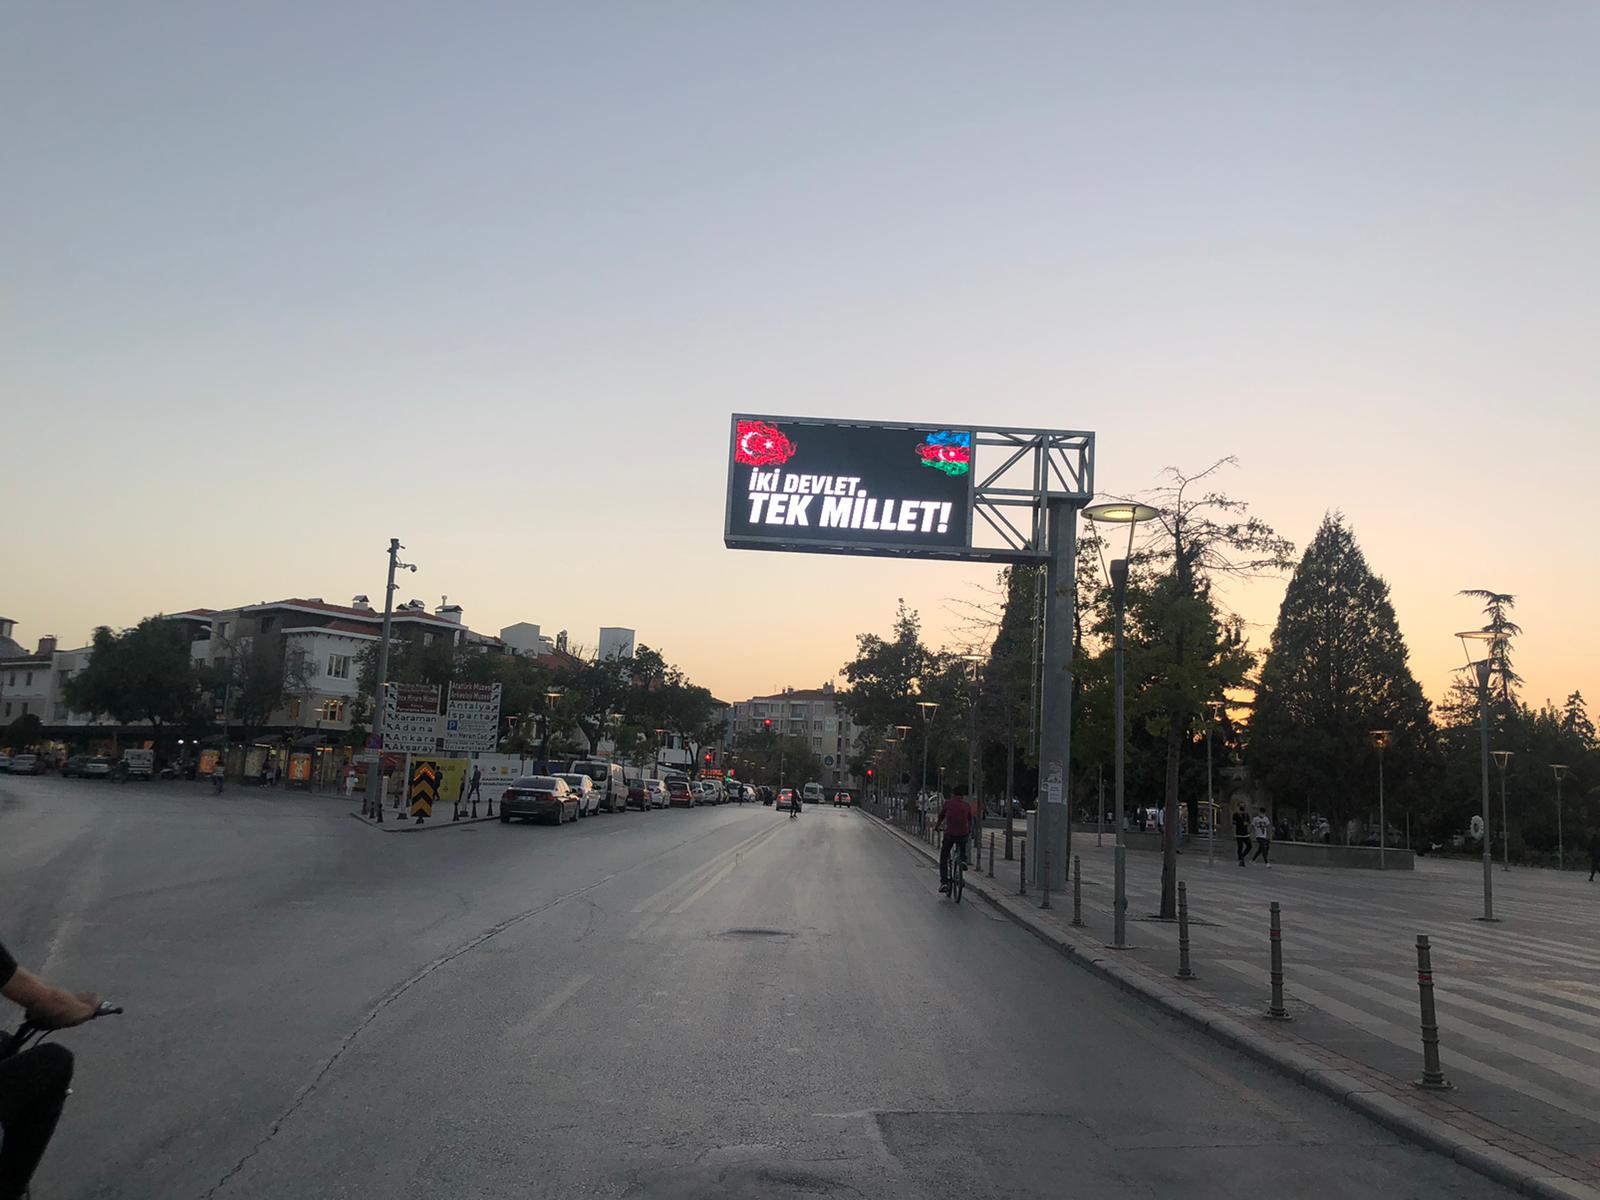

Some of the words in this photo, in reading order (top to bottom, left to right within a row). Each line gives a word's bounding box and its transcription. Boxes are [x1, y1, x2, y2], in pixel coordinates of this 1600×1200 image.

[748, 467, 781, 492] İKİ
[748, 491, 814, 526] TEK
[818, 489, 953, 533] MİLLET!
[449, 701, 491, 712] Antalya
[395, 713, 437, 723] Karaman
[448, 712, 490, 721] Isparta
[394, 723, 433, 732] Adana
[393, 733, 435, 742] Ankara
[392, 743, 434, 753] Aksaray
